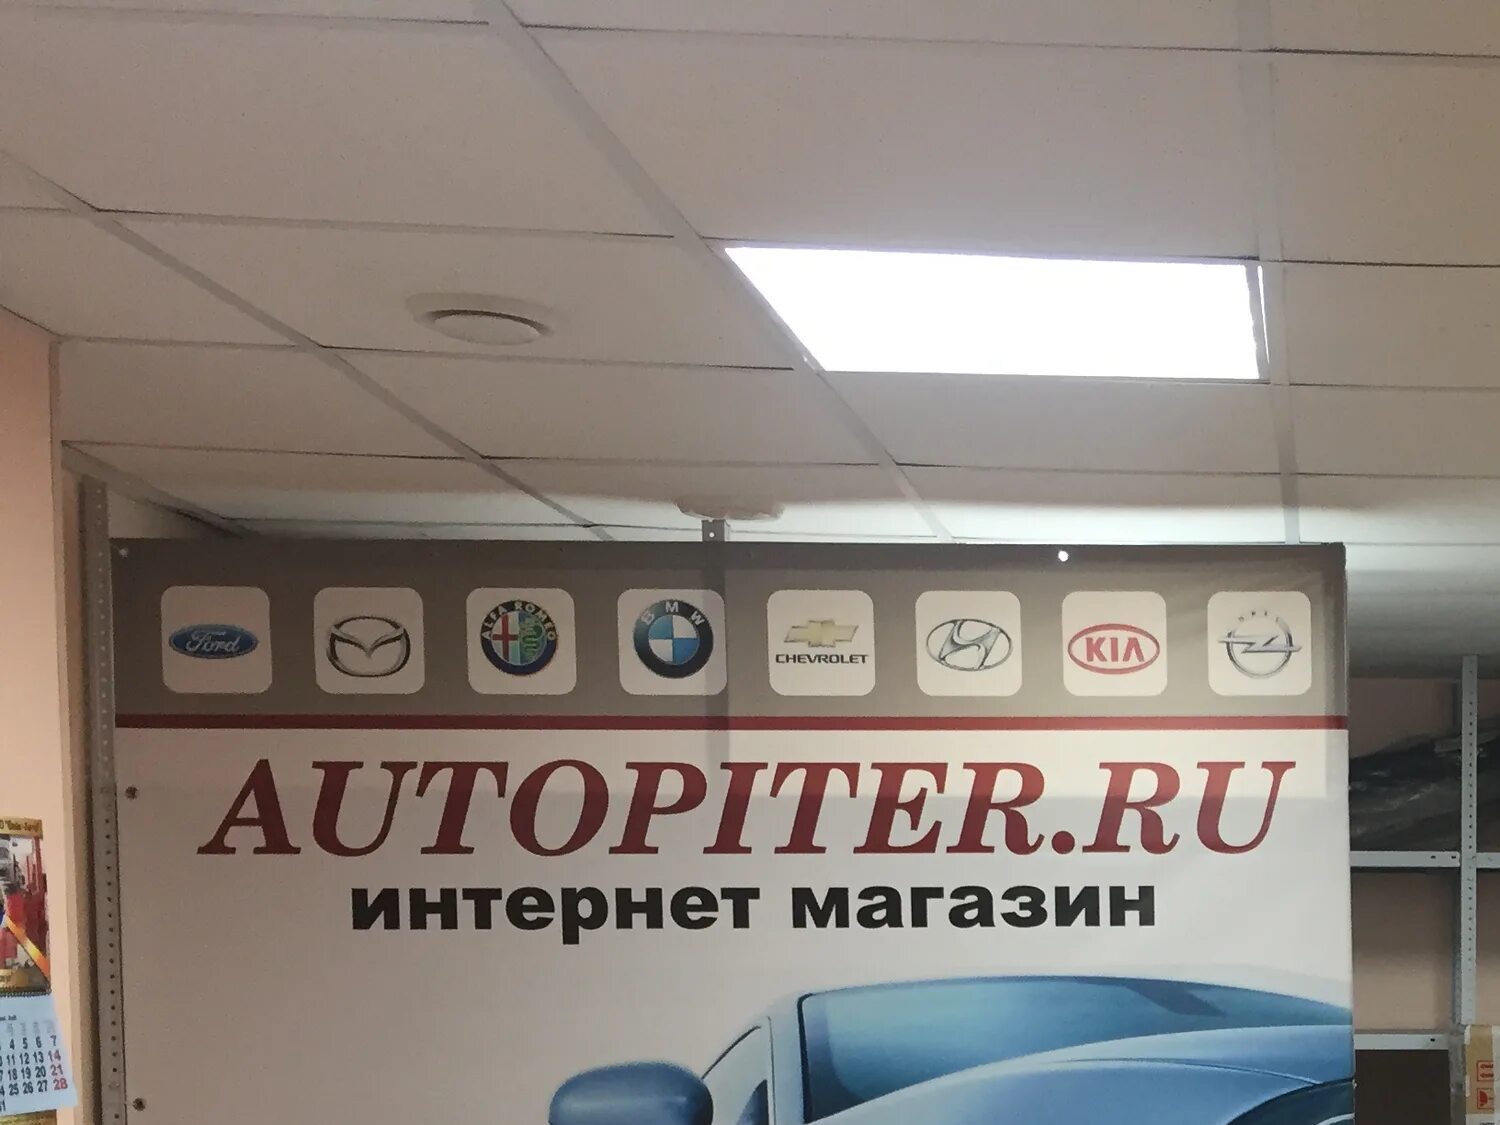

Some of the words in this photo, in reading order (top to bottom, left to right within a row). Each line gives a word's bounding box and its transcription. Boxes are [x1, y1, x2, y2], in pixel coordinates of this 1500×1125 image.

[481, 607, 508, 640] ALFA
[514, 601, 557, 641] ROMEO
[641, 601, 706, 626] BMW
[184, 629, 241, 654] Ford
[1085, 637, 1146, 663] KIA
[774, 653, 869, 665] CHEVROLET
[197, 757, 1297, 857] AUTOPITER.RU
[351, 885, 760, 945] интернет
[792, 884, 1157, 929] магазин
[19, 1052, 30, 1065] 12
[33, 1051, 44, 1063] 13
[48, 1050, 61, 1062] 14
[8, 1068, 18, 1081] 18
[21, 1066, 31, 1080] 19
[35, 1065, 46, 1078] 20
[50, 1064, 63, 1076] 21
[9, 1083, 20, 1096] 25
[22, 1081, 34, 1095] 26
[37, 1079, 48, 1093] 27
[53, 1078, 68, 1091] 28
